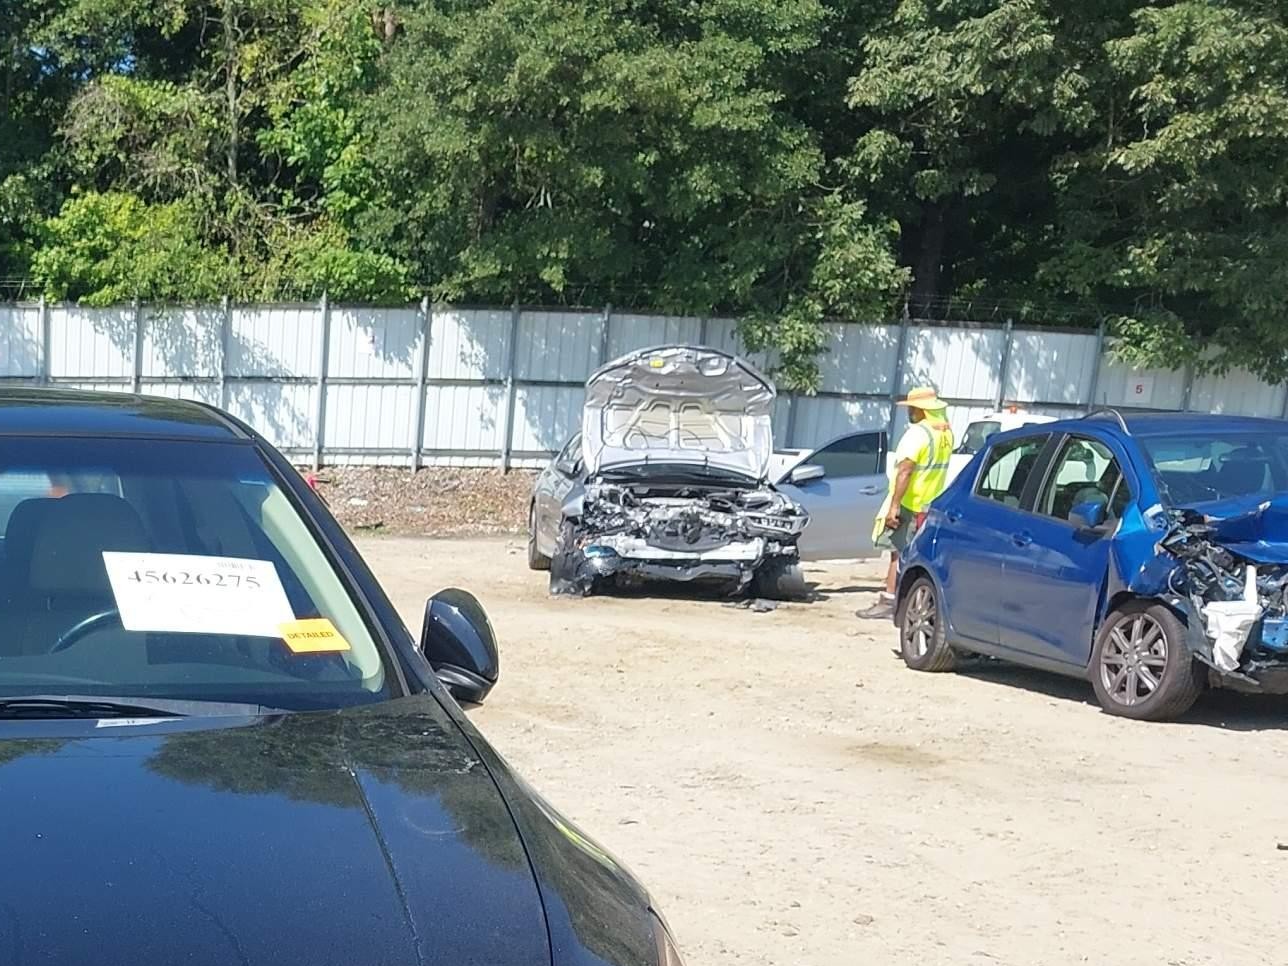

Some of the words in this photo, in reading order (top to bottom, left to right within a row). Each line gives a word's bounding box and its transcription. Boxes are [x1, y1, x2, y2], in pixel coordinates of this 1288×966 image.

[1135, 384, 1144, 394] 5
[127, 569, 261, 590] 45626275
[286, 630, 335, 640] DETAILED
